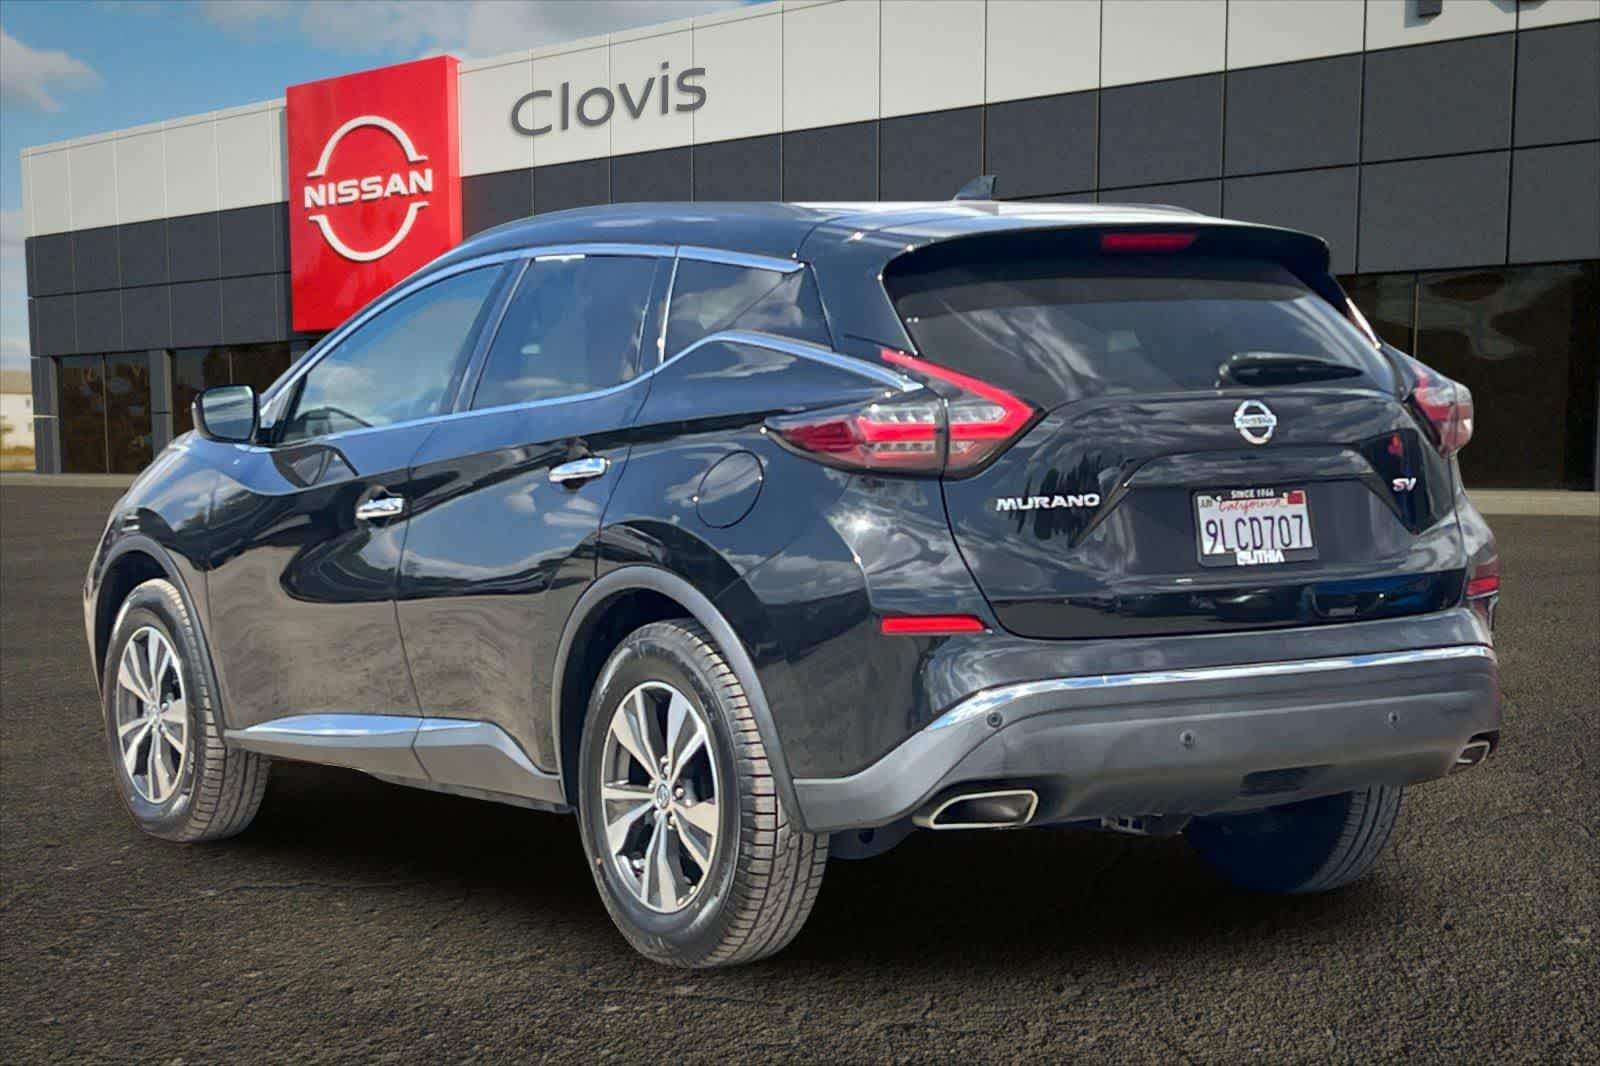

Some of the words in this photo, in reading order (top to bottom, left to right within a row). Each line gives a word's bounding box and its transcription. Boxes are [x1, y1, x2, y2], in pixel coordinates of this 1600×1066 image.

[511, 62, 707, 136] Clovis
[303, 168, 433, 208] NISSAN
[996, 493, 1100, 511] MURANO
[1392, 477, 1417, 492] SV
[1205, 514, 1304, 554] 9LCD707
